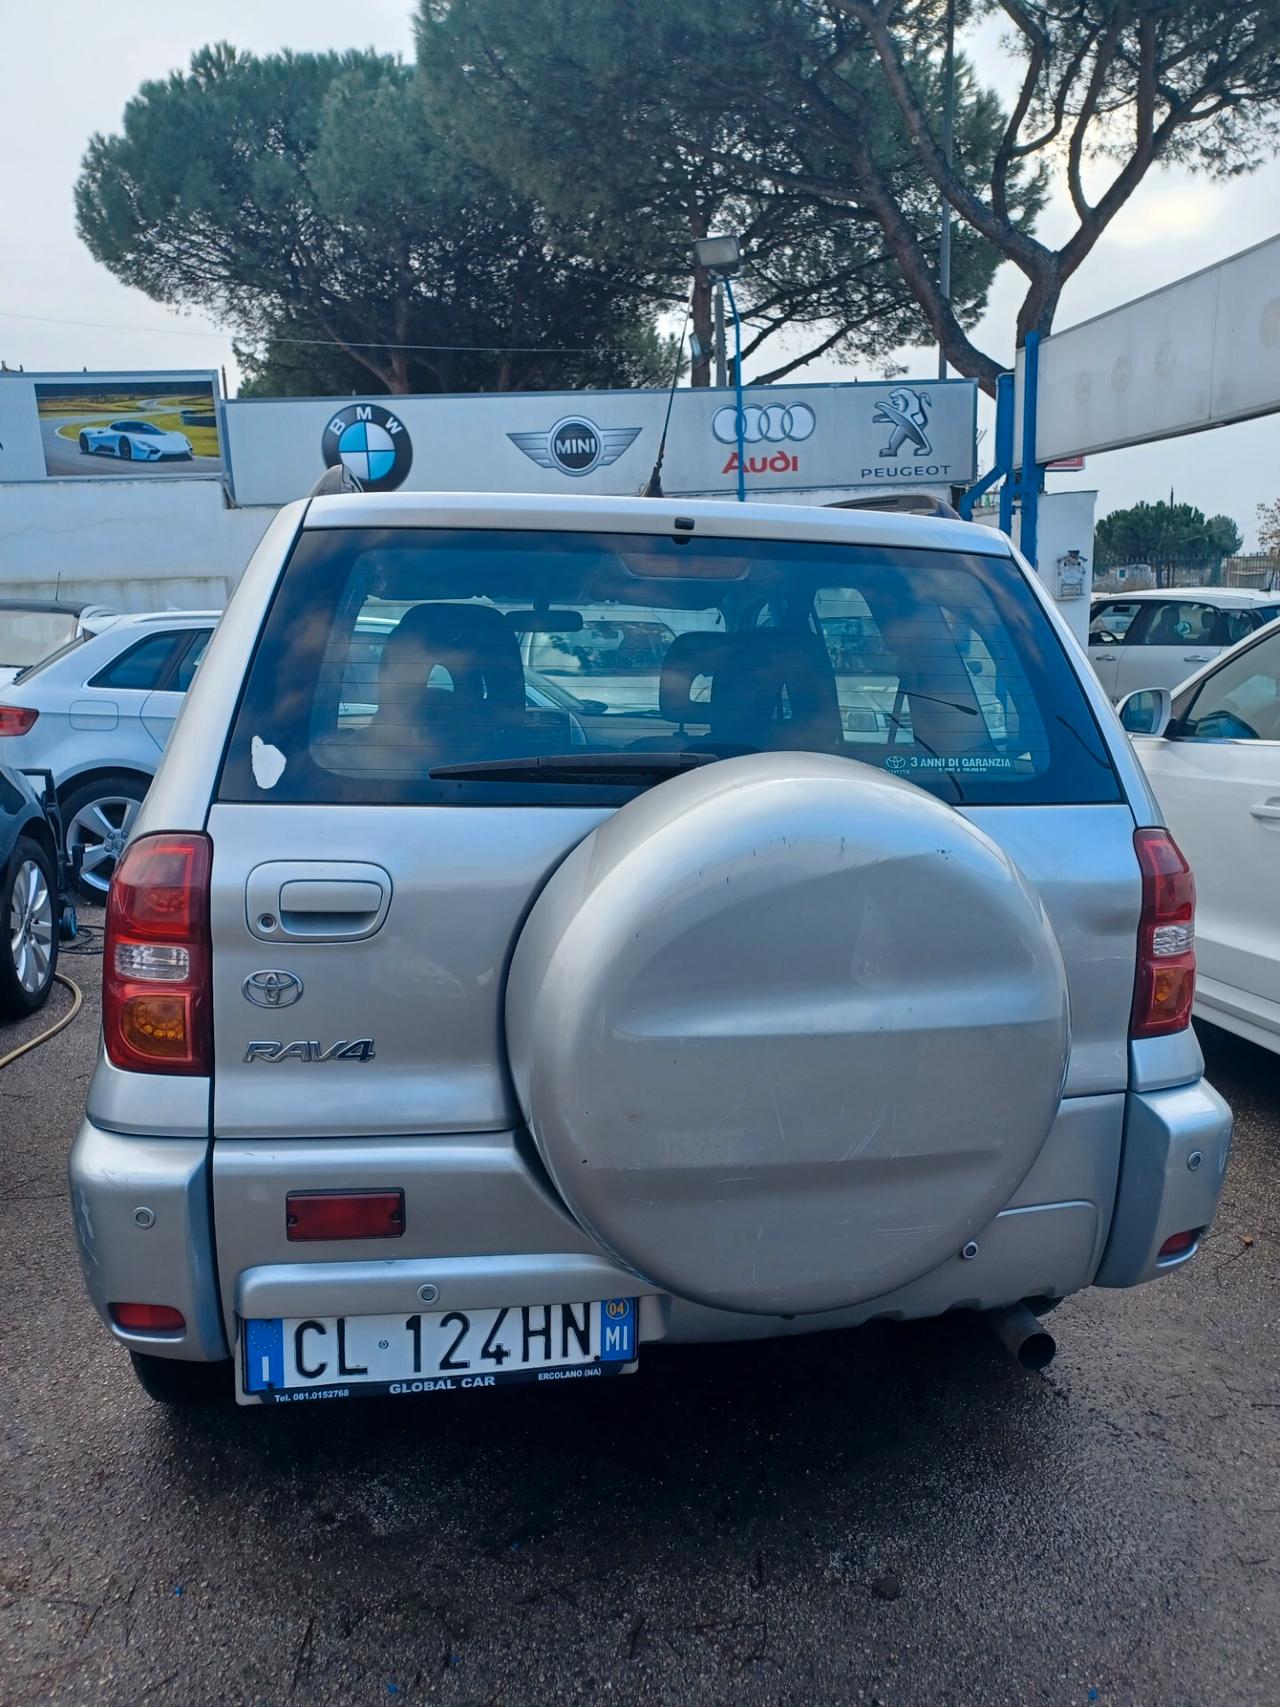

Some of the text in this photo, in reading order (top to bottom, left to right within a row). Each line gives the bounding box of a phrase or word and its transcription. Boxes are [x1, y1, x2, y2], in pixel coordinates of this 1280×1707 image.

[329, 406, 403, 436] BMW
[556, 438, 596, 455] MINI
[722, 451, 798, 473] Audi
[861, 465, 952, 479] PEUGEOT
[910, 756, 1011, 767] 3 ANNI DI GARANZIA
[242, 1038, 376, 1063] RAV4
[610, 1302, 625, 1316] 04
[294, 1317, 368, 1378] CL
[406, 1302, 592, 1373] 124HN
[605, 1325, 628, 1351] MI
[538, 1367, 602, 1381] ERCOLANO (NA)
[389, 1376, 496, 1394] GLOBAL CAR
[274, 1394, 291, 1402] Tel.
